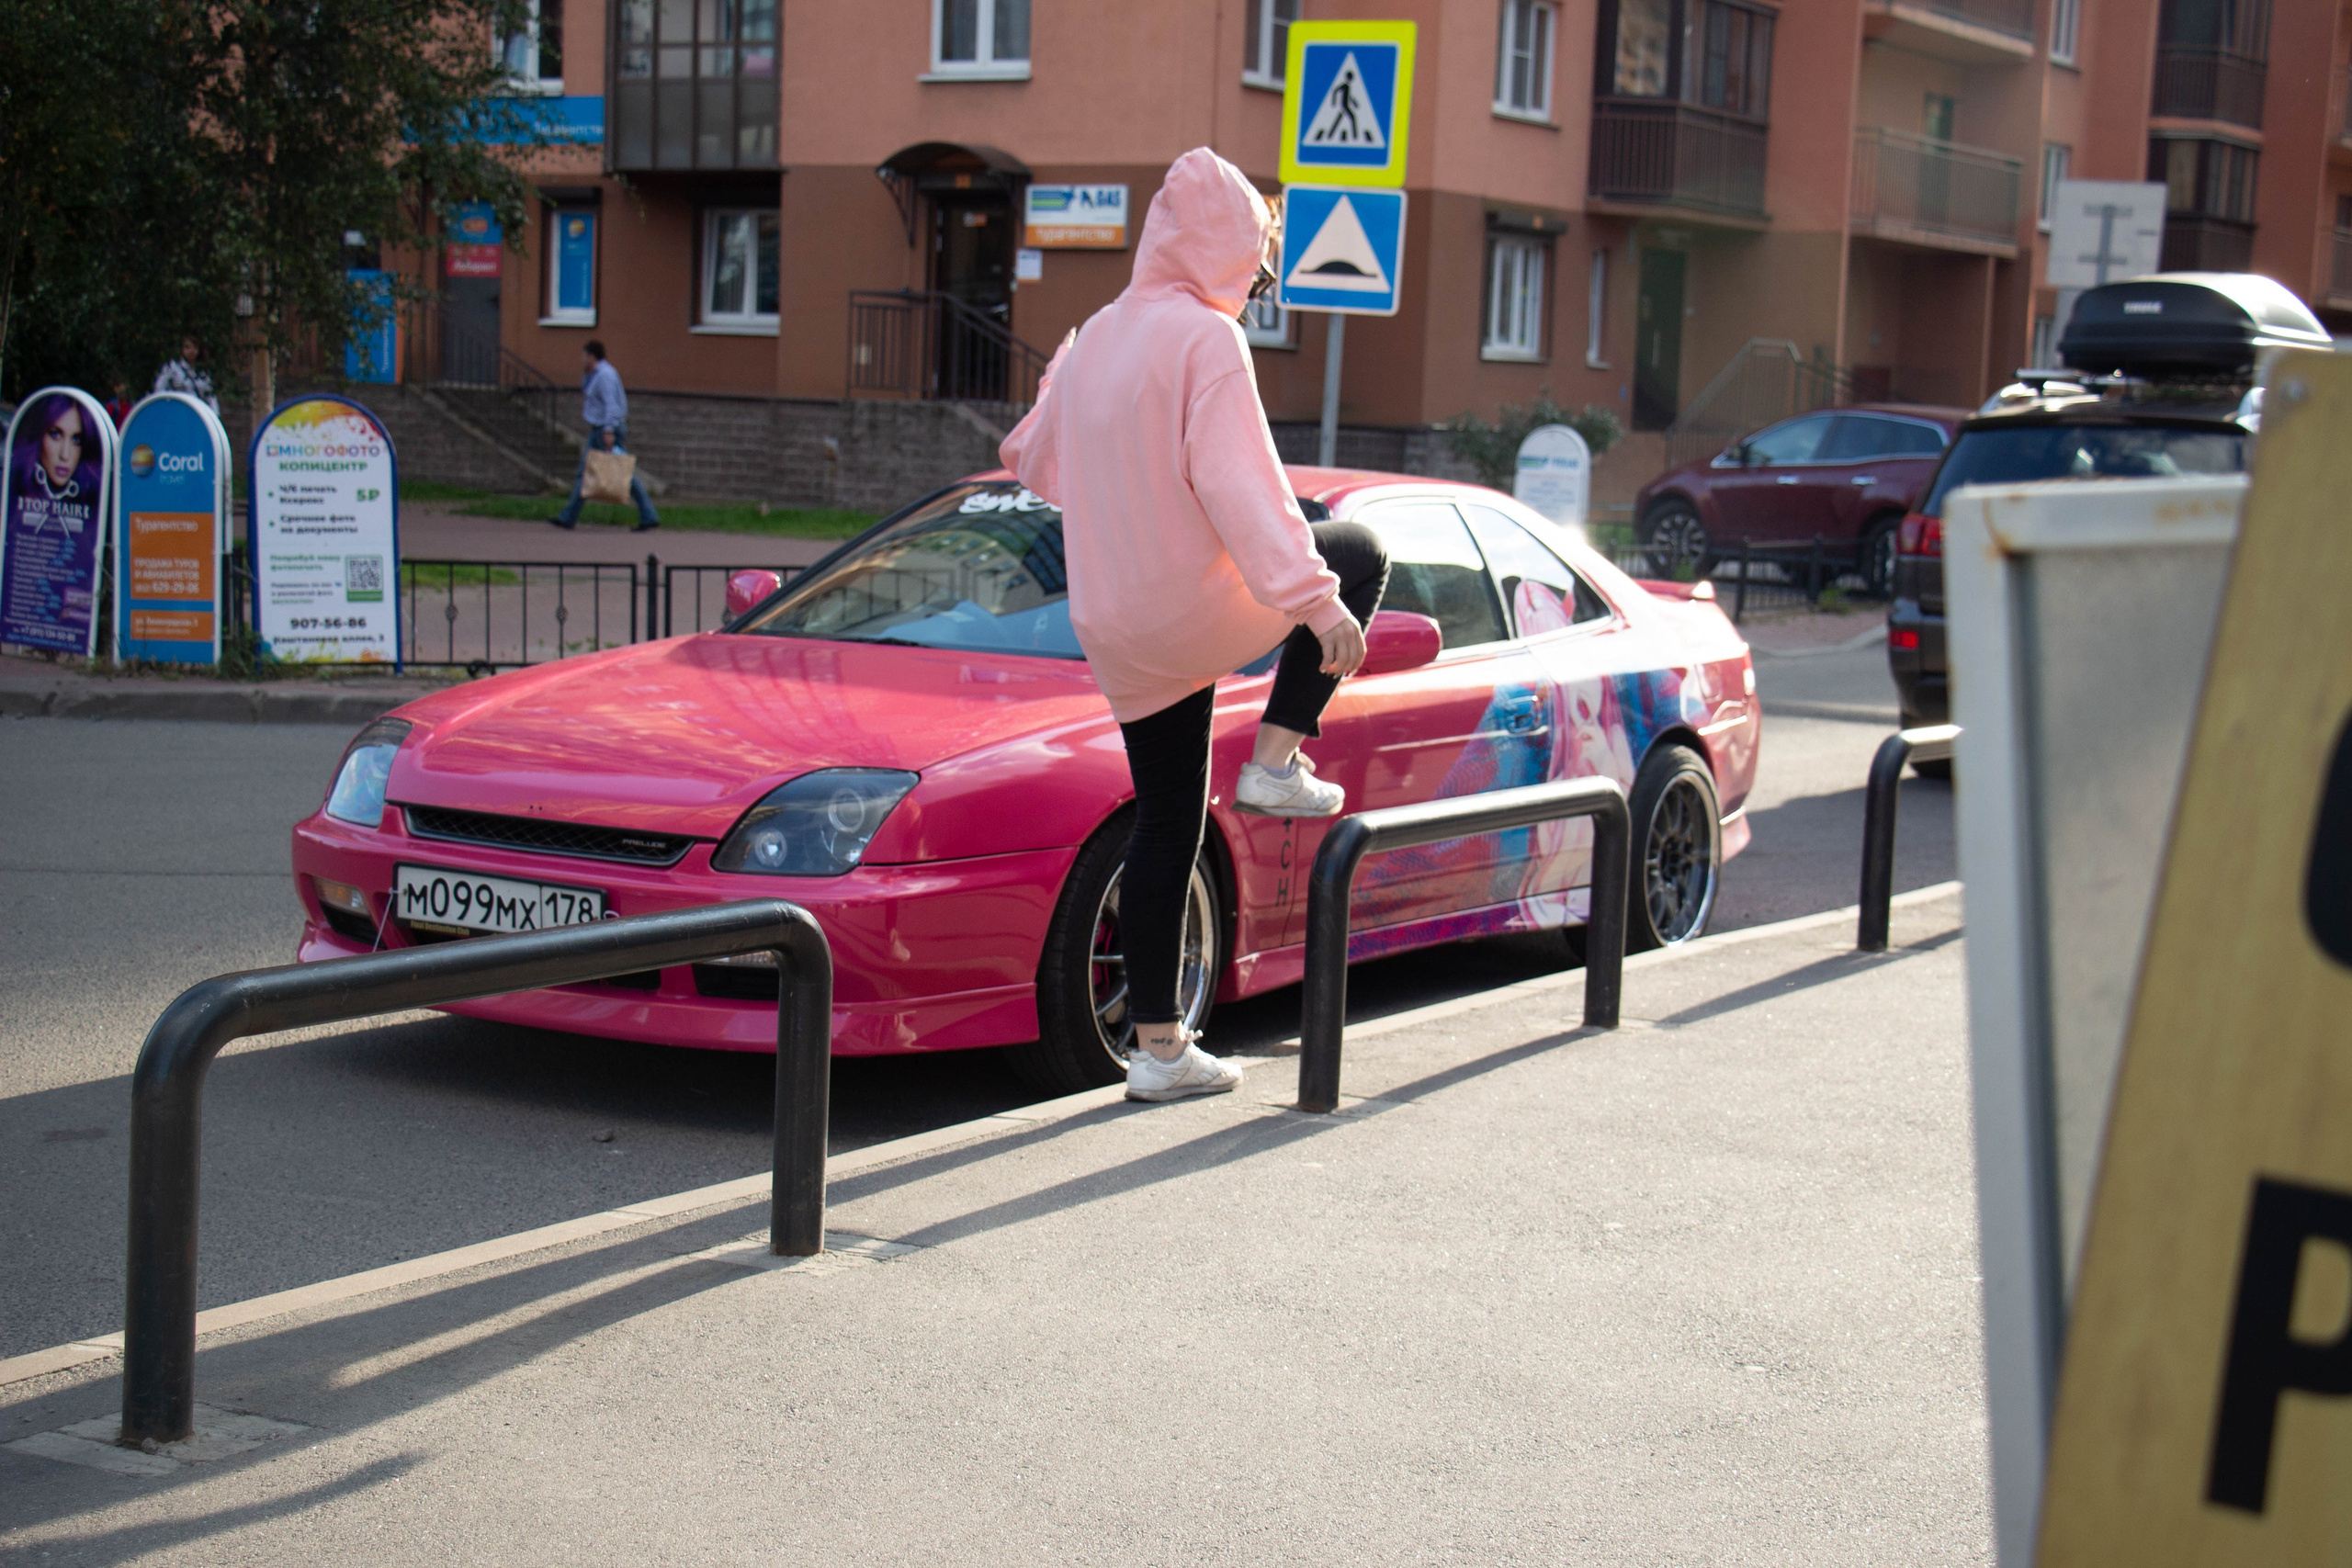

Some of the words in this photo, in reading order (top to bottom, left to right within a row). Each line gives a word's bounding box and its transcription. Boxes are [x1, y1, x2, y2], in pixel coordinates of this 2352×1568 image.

[158, 451, 204, 472] Coral
[278, 460, 368, 472] КОПИЦЕНТР
[25, 497, 50, 512] TOP
[622, 838, 666, 849] PRELUDE
[544, 891, 595, 926] 178
